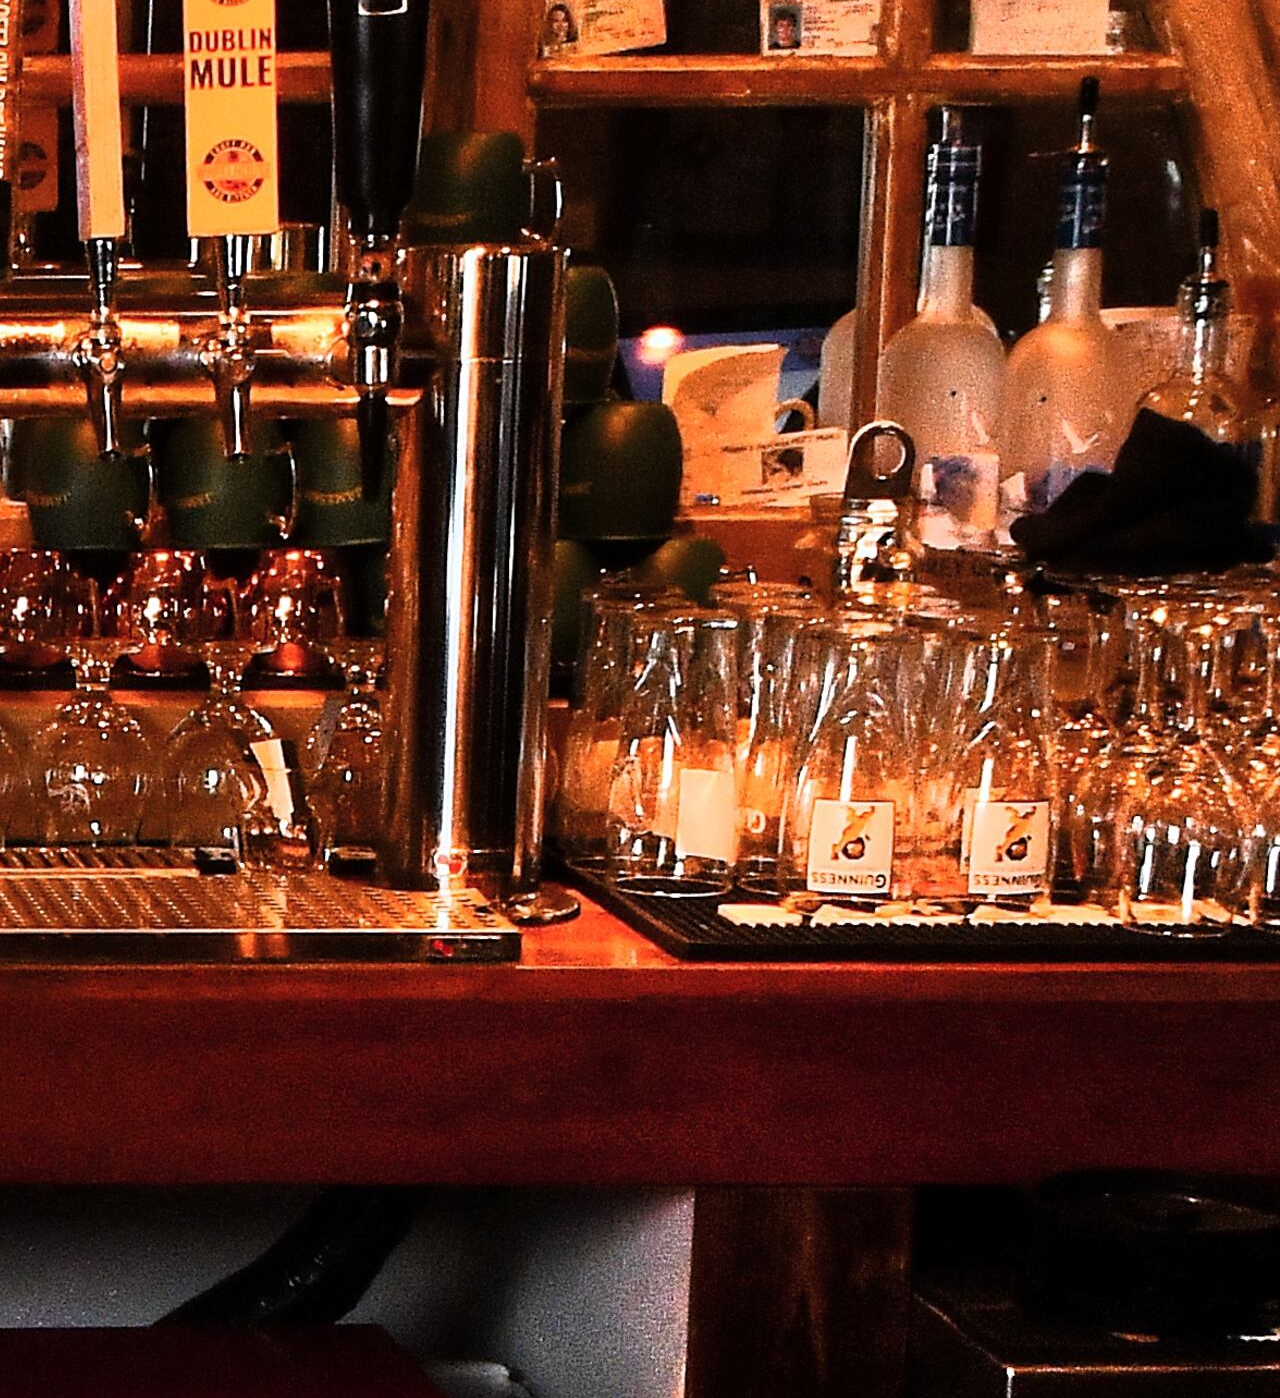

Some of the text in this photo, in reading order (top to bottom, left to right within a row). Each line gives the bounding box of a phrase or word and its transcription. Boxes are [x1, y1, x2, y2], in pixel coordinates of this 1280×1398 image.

[189, 28, 272, 53] DUBLIN
[190, 55, 273, 90] MULE
[811, 871, 887, 889] GUINNESS
